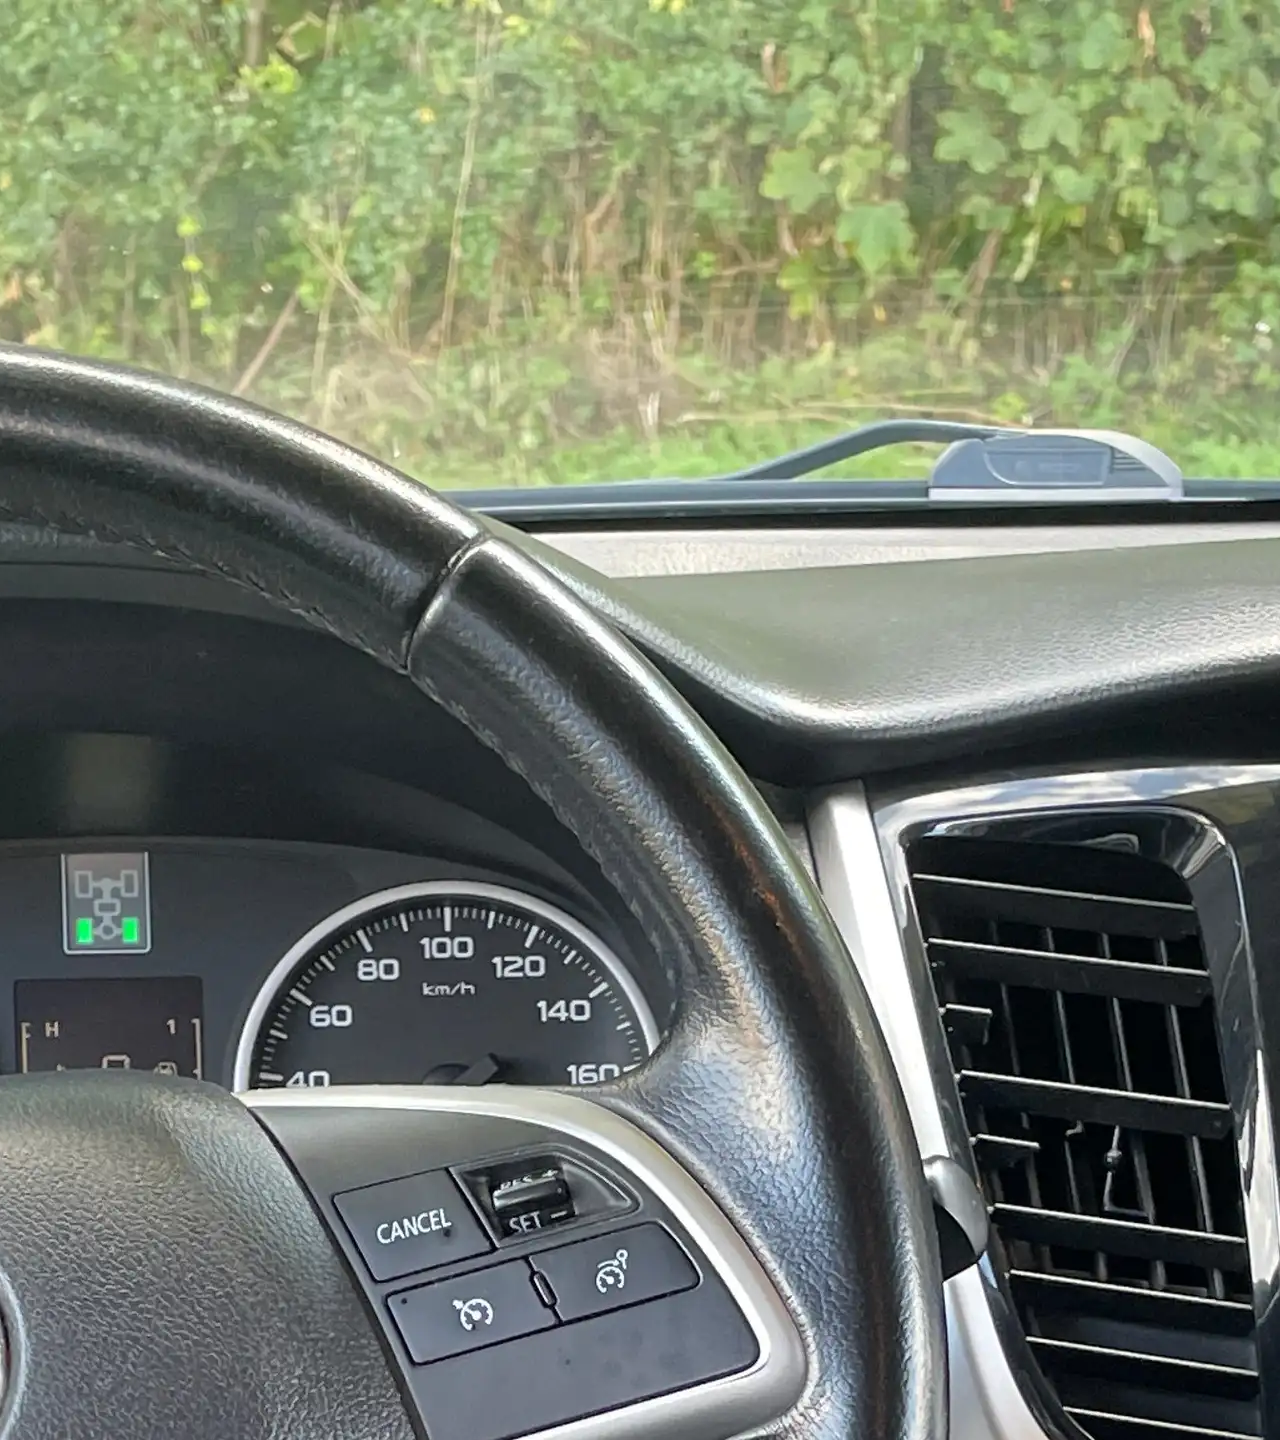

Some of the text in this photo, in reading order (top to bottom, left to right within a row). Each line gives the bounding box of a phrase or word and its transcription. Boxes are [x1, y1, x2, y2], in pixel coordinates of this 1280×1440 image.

[420, 936, 474, 958] 100
[357, 958, 400, 981] 80
[492, 955, 546, 977] 120
[422, 983, 476, 996] km/h
[309, 1004, 353, 1027] 60
[536, 999, 591, 1021] 140
[45, 1021, 59, 1038] H
[287, 1071, 330, 1087] 40
[568, 1064, 619, 1085] 160
[376, 1207, 452, 1244] CANCEL
[509, 1211, 542, 1233] SET
